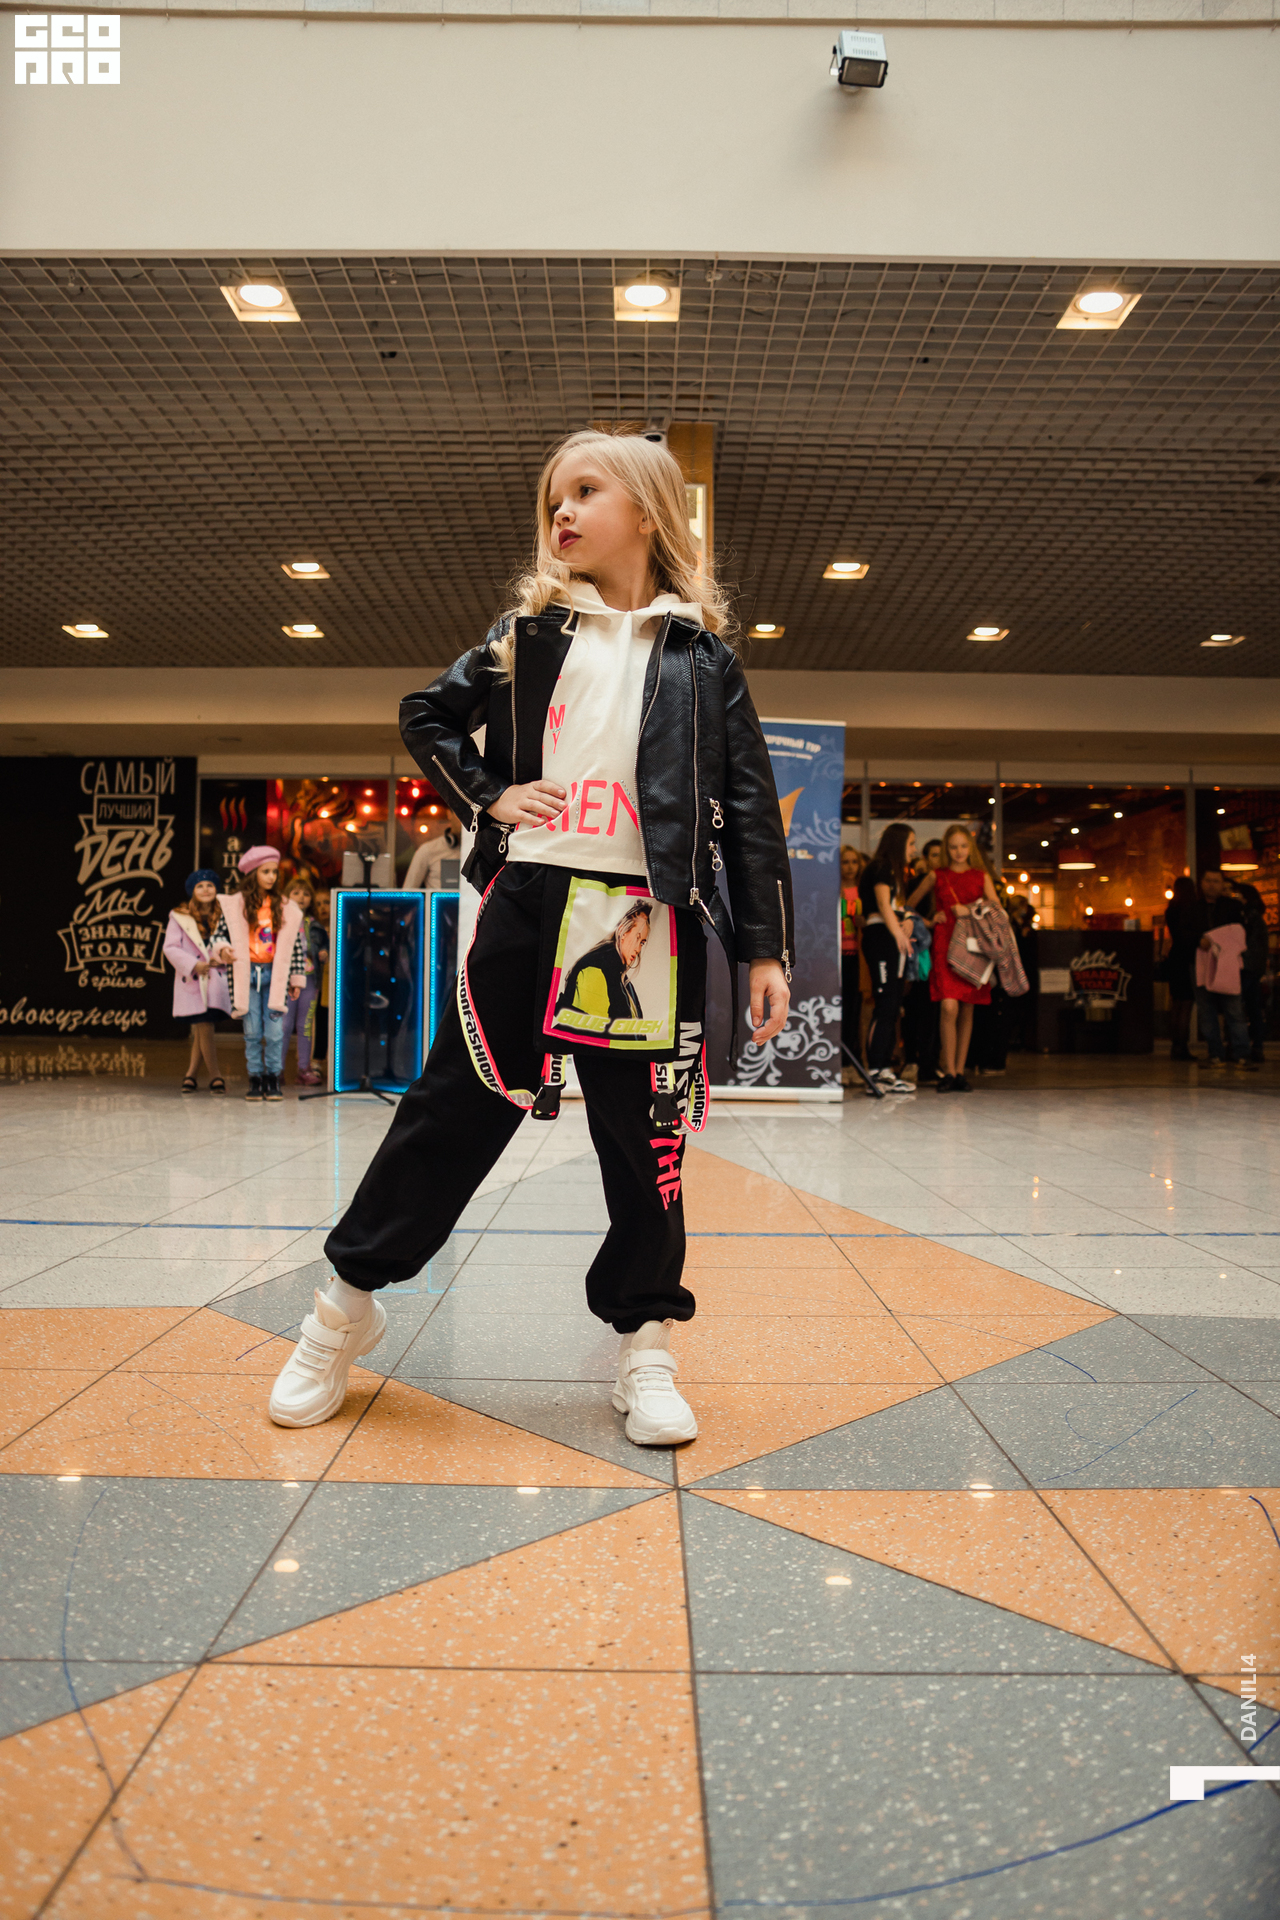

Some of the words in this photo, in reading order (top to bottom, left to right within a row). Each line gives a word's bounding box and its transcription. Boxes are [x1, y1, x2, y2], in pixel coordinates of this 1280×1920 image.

[80, 756, 176, 795] САМЫЙ
[98, 801, 153, 820] ЛУЧШИЙ
[74, 828, 175, 885] ДЕНЬ
[80, 923, 152, 941] ЗНАЕМ
[81, 942, 147, 958] ТОЛК
[78, 969, 89, 988] в
[92, 975, 146, 992] гриле
[0, 996, 148, 1032] овокузнецк
[556, 1008, 611, 1033] BILLIE
[608, 1018, 664, 1034] EILISH
[649, 1134, 684, 1211] THE
